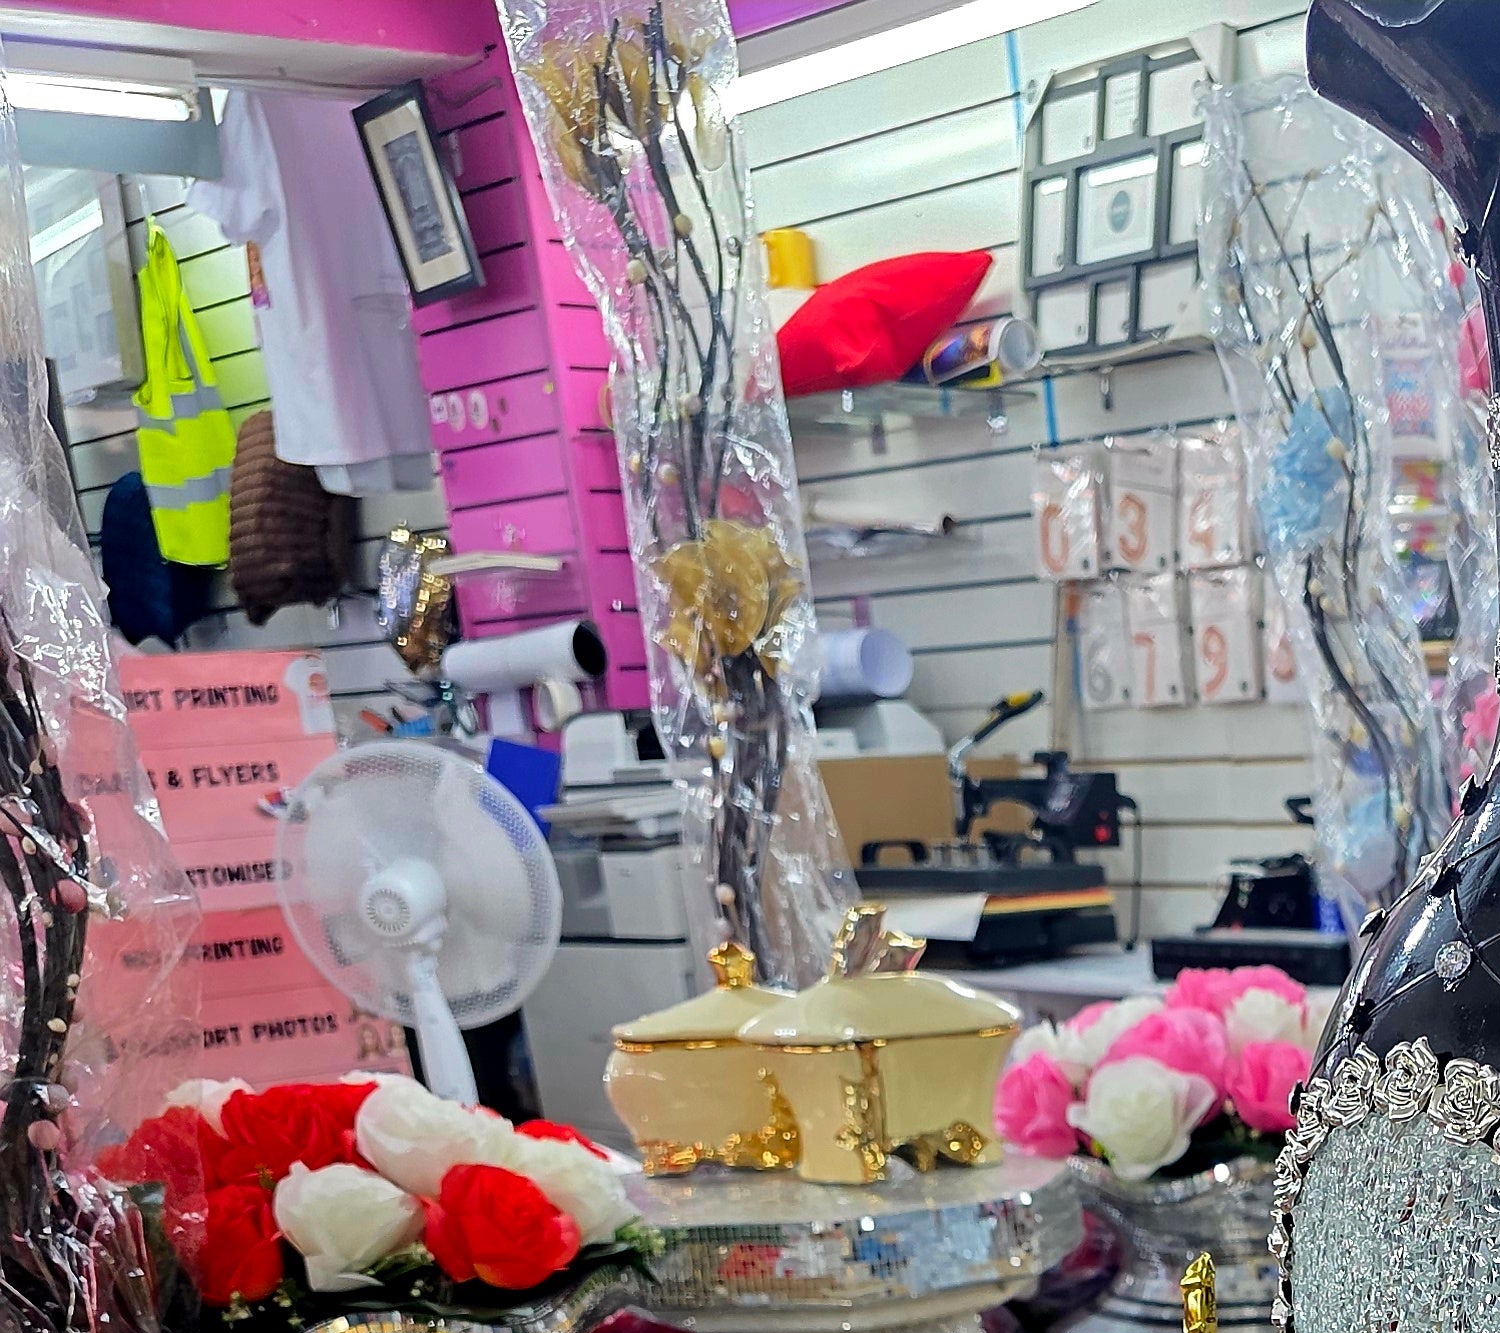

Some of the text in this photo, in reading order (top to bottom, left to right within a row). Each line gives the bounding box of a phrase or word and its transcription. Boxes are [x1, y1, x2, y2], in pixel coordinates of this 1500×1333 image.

[1118, 492, 1147, 563] 3
[1133, 631, 1156, 700] 7
[1203, 625, 1227, 698] 9
[174, 683, 279, 711] PRINTING
[164, 768, 182, 789] &
[192, 761, 280, 788] FLYERS
[252, 1014, 337, 1042] PHOTOS
